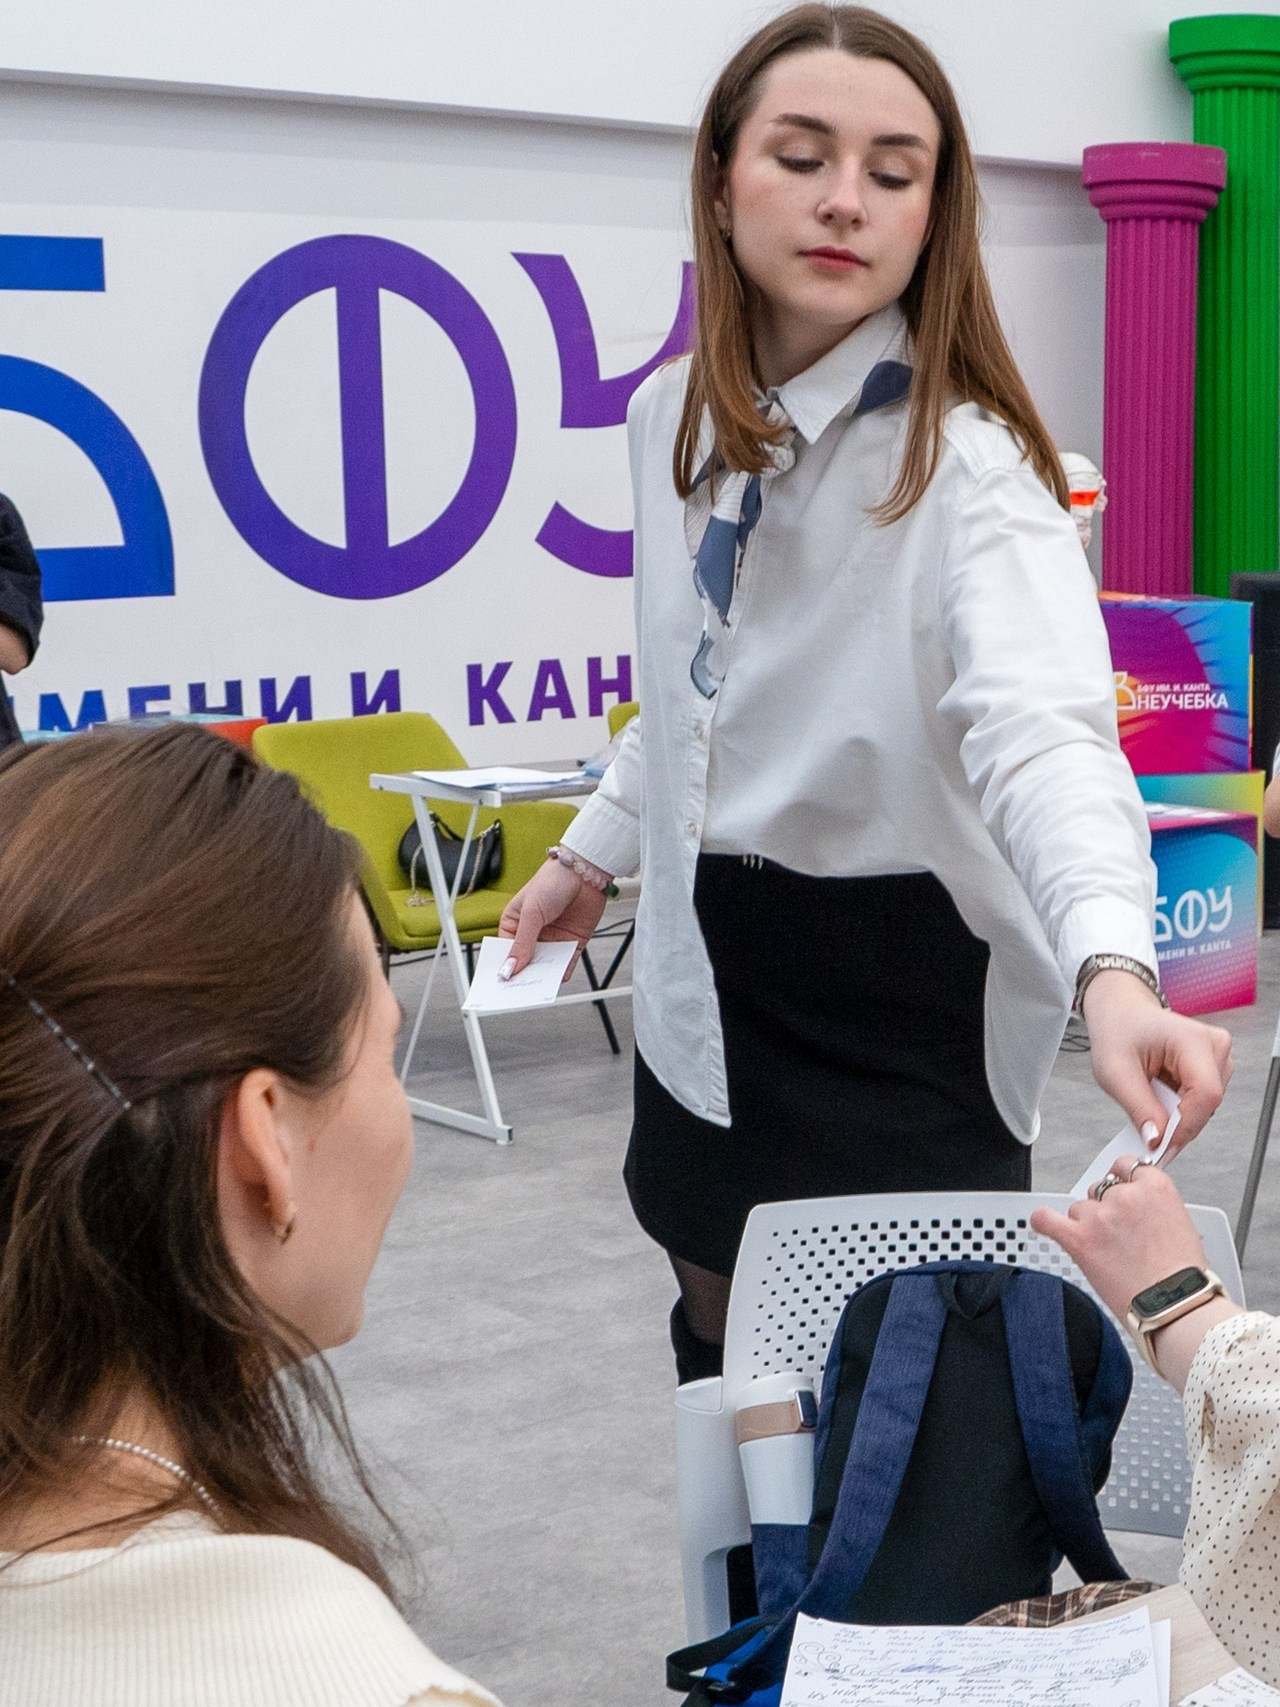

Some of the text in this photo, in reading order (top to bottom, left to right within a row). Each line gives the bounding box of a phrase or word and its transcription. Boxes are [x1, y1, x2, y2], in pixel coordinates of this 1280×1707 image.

[8, 675, 312, 732] МЕНИ
[1153, 885, 1233, 943] БФУ
[1200, 940, 1231, 953] КАНТА
